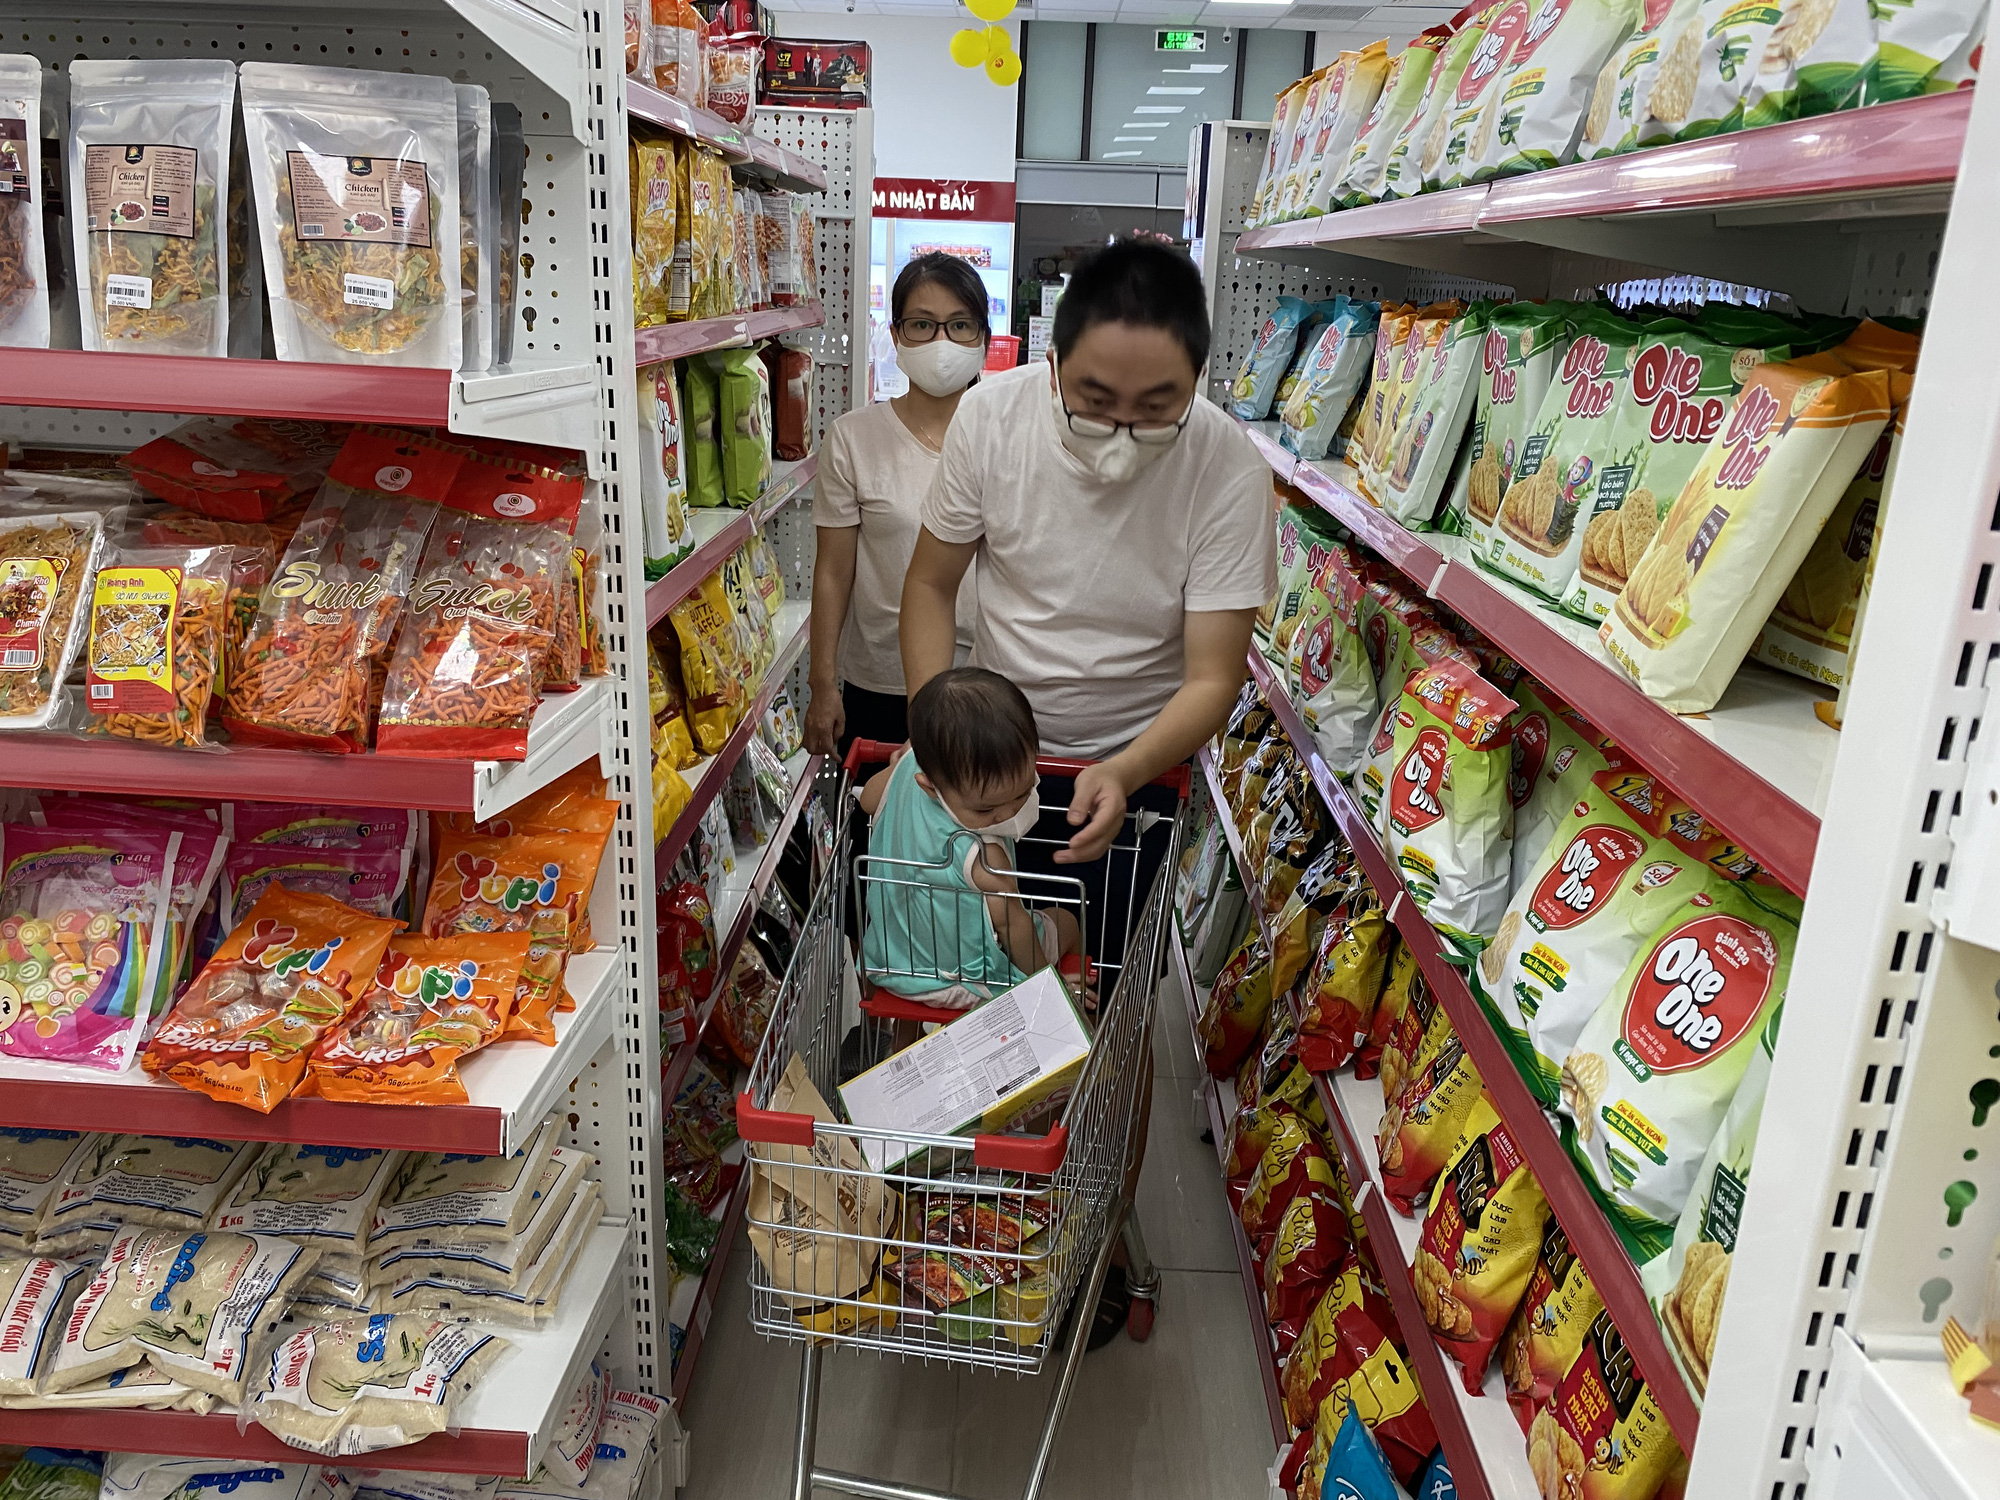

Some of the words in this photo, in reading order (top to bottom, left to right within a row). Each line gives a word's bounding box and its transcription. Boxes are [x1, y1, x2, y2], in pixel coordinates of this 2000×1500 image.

[1167, 32, 1194, 42] EXIT
[119, 172, 145, 181] Chicken
[345, 183, 379, 193] Chicken
[889, 189, 937, 212] NHẬT
[940, 189, 975, 211] BẢN
[1483, 328, 1508, 374] One
[1562, 334, 1610, 385] One
[1492, 364, 1516, 404] One
[1566, 371, 1614, 418] One
[1633, 342, 1703, 406] One
[1650, 389, 1725, 444] One
[1722, 384, 1780, 448] One
[1714, 434, 1771, 490] One
[165, 569, 181, 585] NEW
[272, 561, 384, 610] Snack
[412, 579, 538, 623] Snack
[443, 607, 467, 620] Que
[1404, 750, 1432, 788] One
[1562, 838, 1601, 881] One
[1600, 836, 1614, 851] Bánh
[1613, 845, 1626, 861] gạo
[453, 851, 562, 912] Yupi
[1554, 872, 1595, 912] One
[242, 917, 344, 980] Yupi
[1715, 931, 1740, 951] Bánh
[1734, 945, 1751, 966] gạo
[375, 948, 479, 1007] Yupi
[1653, 937, 1726, 1008] One
[162, 1025, 270, 1053] BURGER
[1654, 984, 1724, 1053] One
[1623, 1048, 1639, 1067] ngọt
[1635, 1064, 1647, 1077] dịu
[1645, 1125, 1663, 1144] NGON
[615, 1391, 638, 1406] XUẤT
[637, 1397, 660, 1414] KHẨU
[1578, 1386, 1600, 1422] GẠO
[1582, 1366, 1610, 1412] BÁNH
[622, 1413, 640, 1423] NAM
[1567, 1394, 1593, 1437] NHẬT
